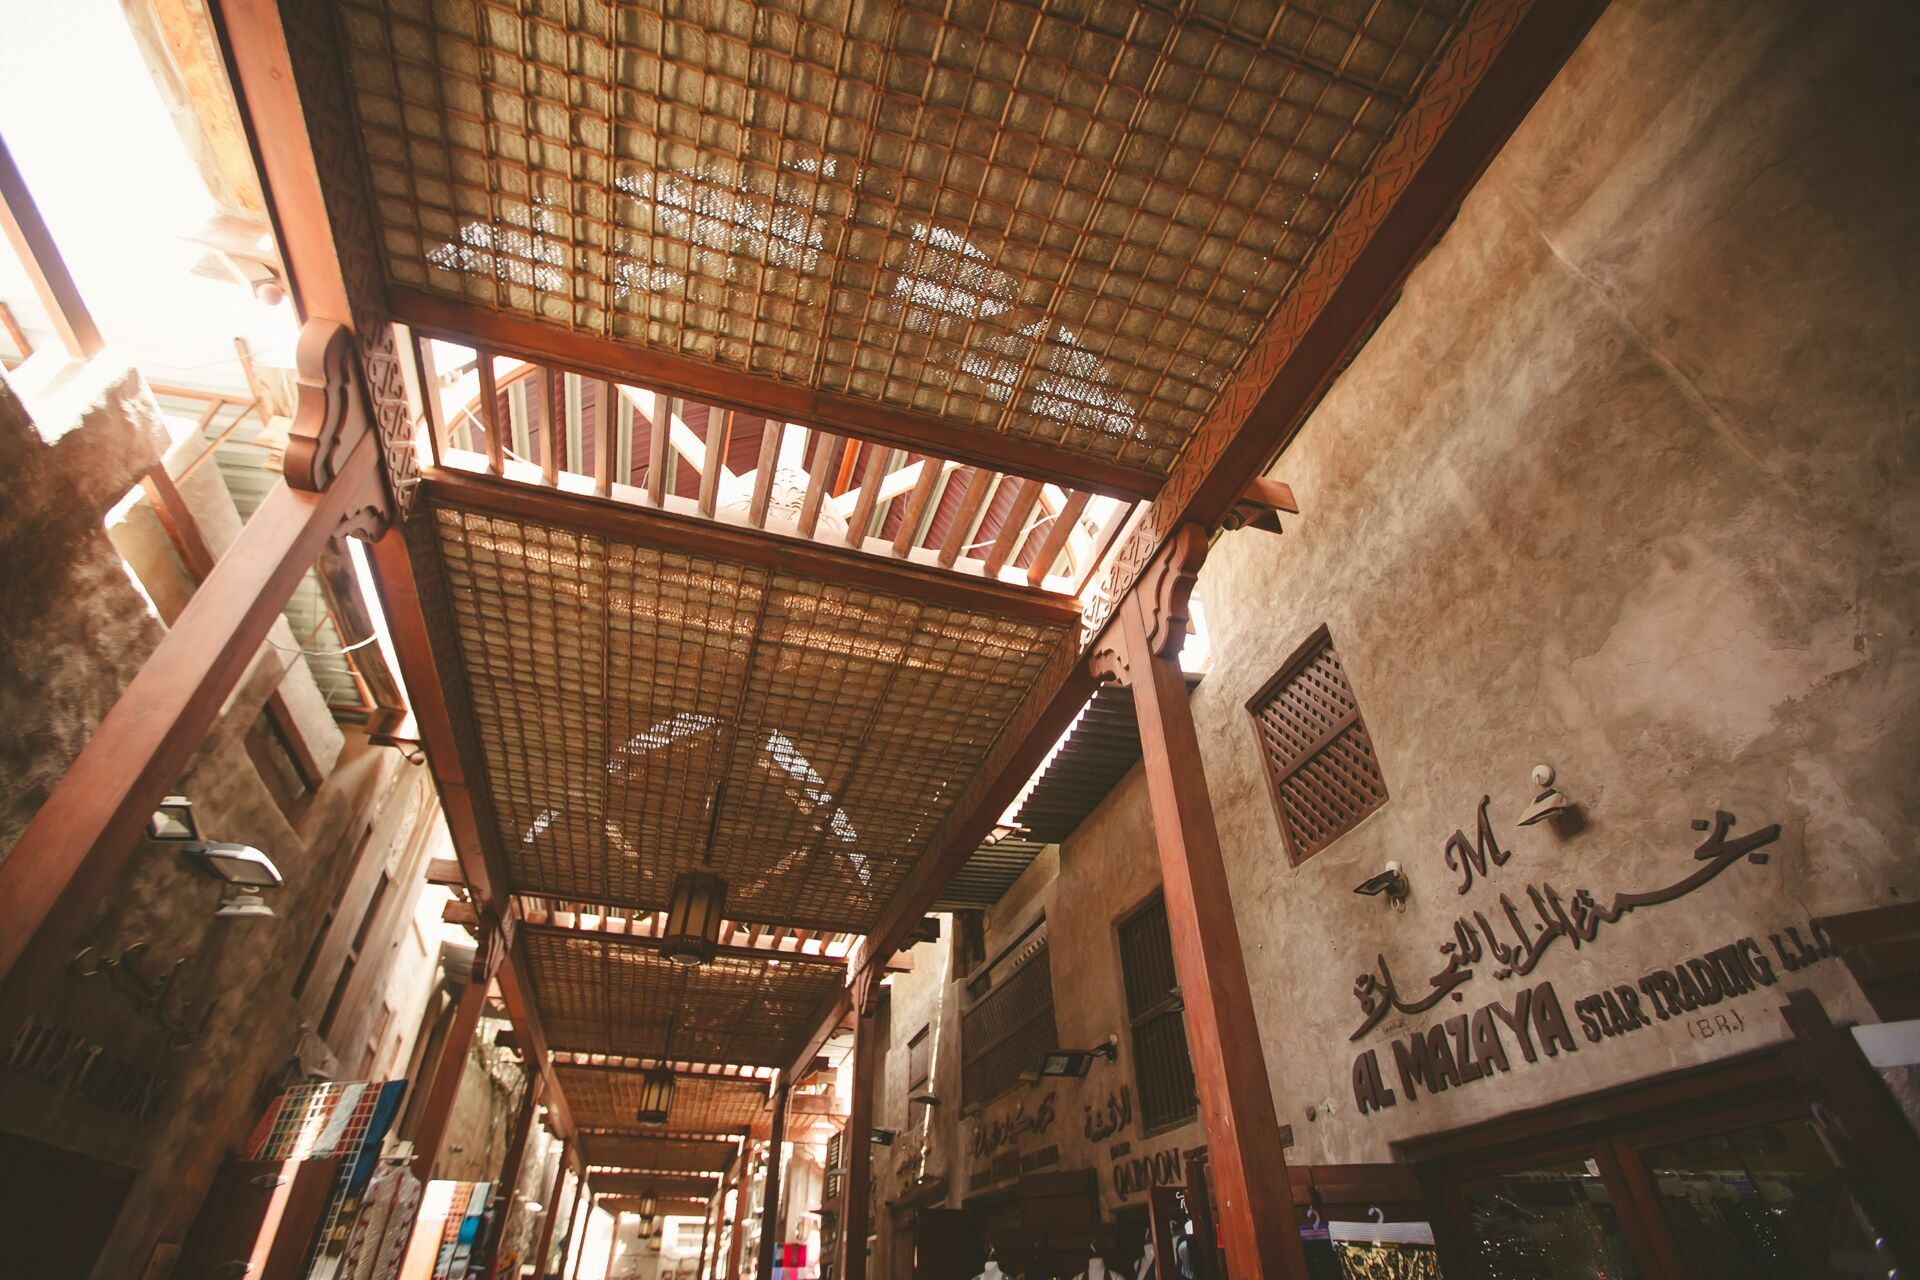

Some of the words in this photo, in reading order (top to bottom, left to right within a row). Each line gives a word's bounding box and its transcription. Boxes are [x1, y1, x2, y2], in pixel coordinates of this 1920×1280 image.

[1352, 1048, 1396, 1114] AL
[1391, 980, 1577, 1101] MAZAYA
[1575, 984, 1652, 1043] STAR
[1640, 936, 1777, 1021] TRADING
